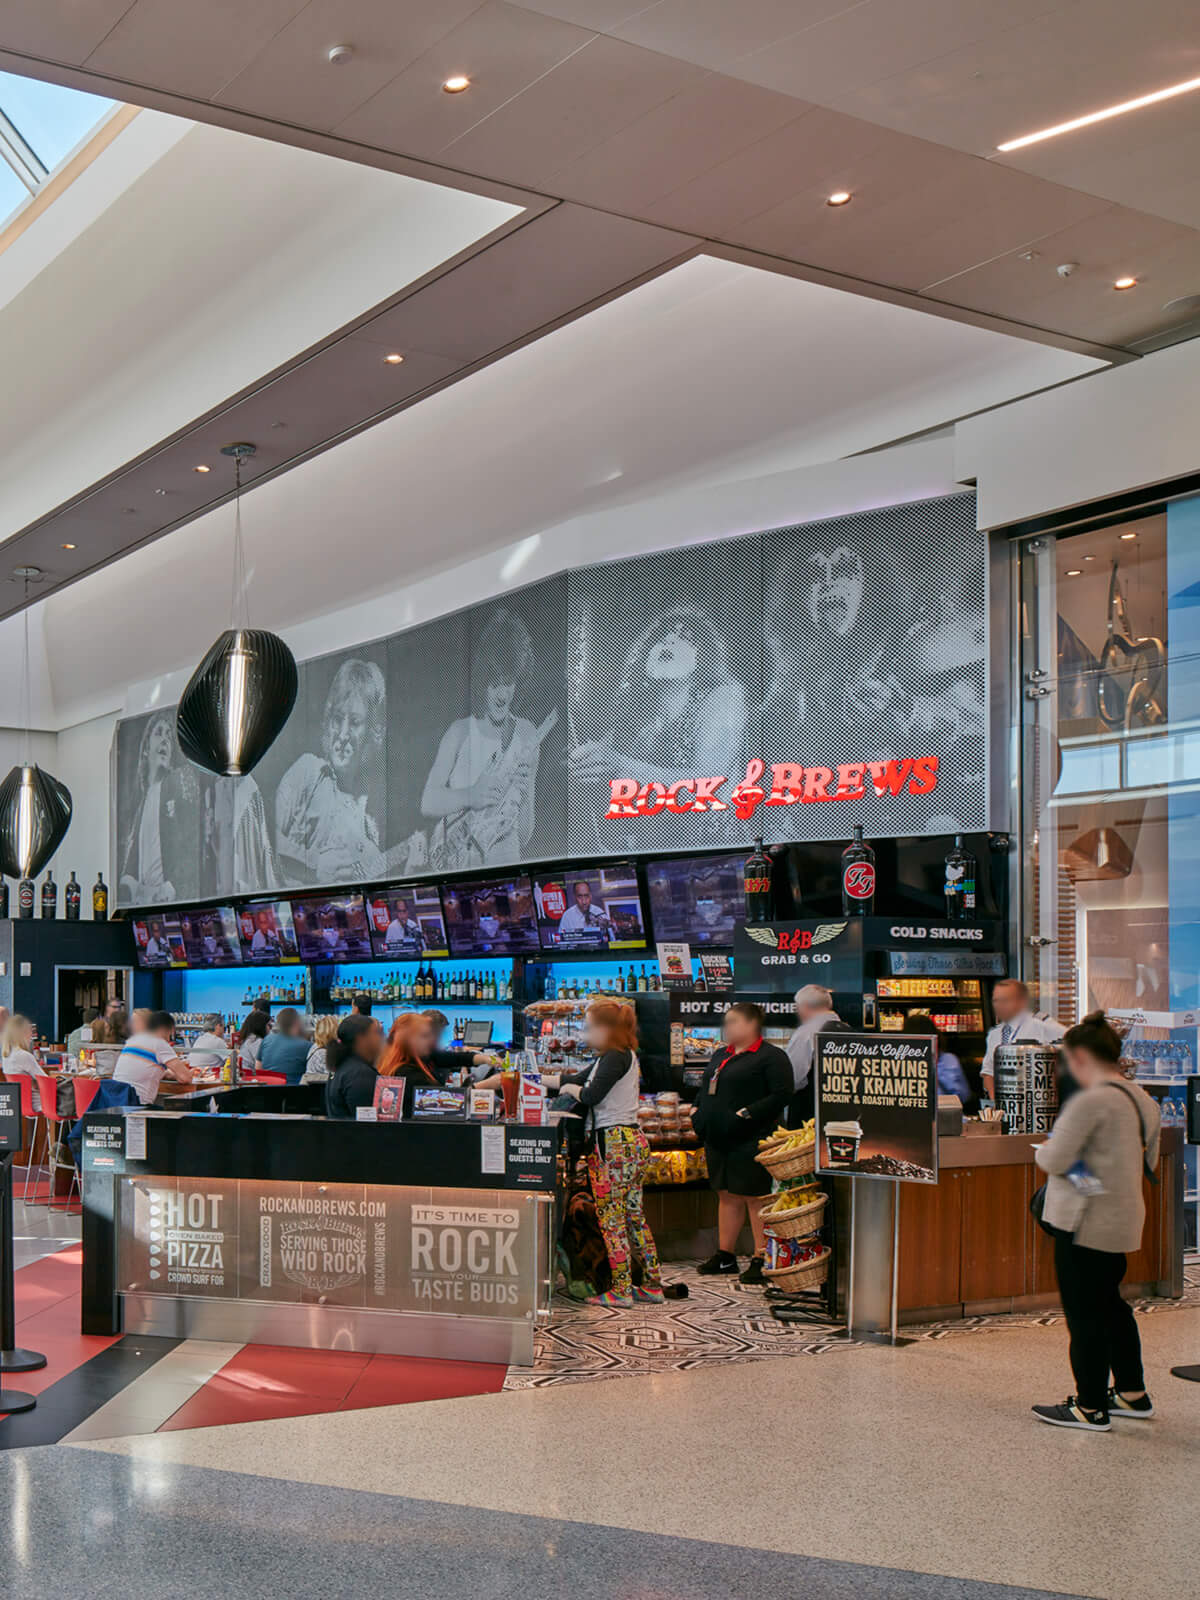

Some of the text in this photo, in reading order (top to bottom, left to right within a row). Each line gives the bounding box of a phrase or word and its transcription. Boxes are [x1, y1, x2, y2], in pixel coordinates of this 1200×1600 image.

[604, 776, 729, 819] ROCK
[766, 756, 939, 807] BREWS
[890, 926, 983, 940] COLD SNACKS
[761, 953, 831, 965] GRAB & GO
[680, 1002, 798, 1013] HOT SAICHE
[823, 1041, 928, 1060] But First Coffee!
[823, 1057, 928, 1078] NOW SERVING
[822, 1075, 928, 1097] JOEY KRAMER
[823, 1094, 928, 1108] ROCKIN' & ROASTIN' COFFEE
[510, 1139, 551, 1148] SEATING FOR
[509, 1154, 551, 1163] GUESTS ONLY
[167, 1192, 223, 1229] HOT
[259, 1196, 386, 1217] ROCKANDBREWS.COM
[416, 1210, 515, 1224] IT'S TIME TO
[194, 1233, 223, 1241] BAKED
[280, 1235, 367, 1254] SERVING THOSE
[167, 1242, 224, 1268] PIZZA
[374, 1222, 386, 1296] #ROCKANDBREWS
[411, 1227, 519, 1276] ROCK
[280, 1250, 367, 1275] WHO ROCK
[168, 1272, 224, 1286] CROWD SURF FOR
[450, 1272, 480, 1280] YOUR
[412, 1278, 518, 1305] TASTE BUDS
